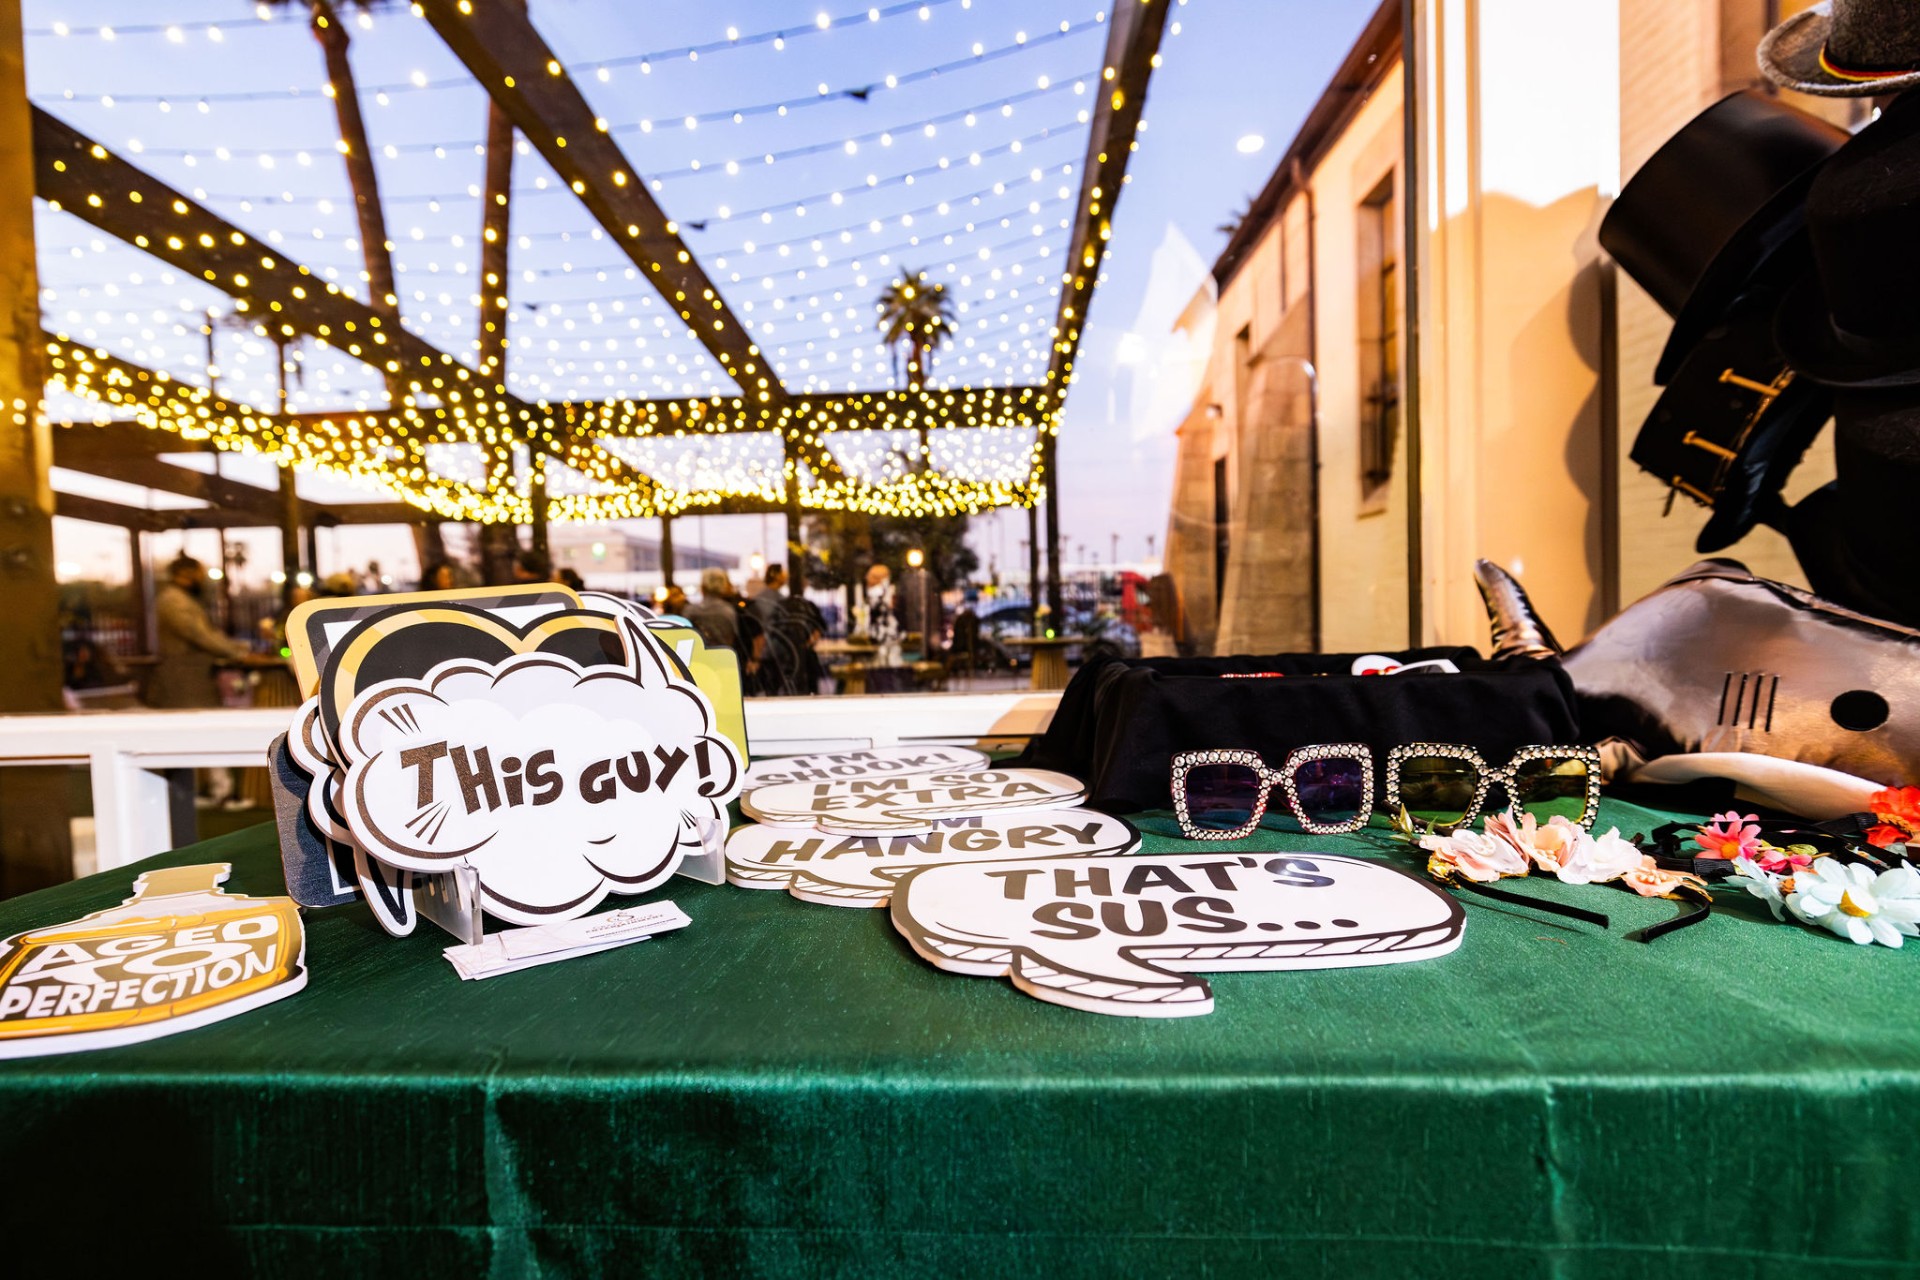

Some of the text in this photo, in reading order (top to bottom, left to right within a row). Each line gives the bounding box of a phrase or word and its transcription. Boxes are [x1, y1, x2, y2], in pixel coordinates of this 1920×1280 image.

[579, 740, 716, 804] GUY!
[755, 753, 957, 786] SHOOK!
[793, 752, 877, 768] I'M
[811, 782, 1052, 811] EXTRA
[814, 772, 1010, 796] I'M SO
[760, 822, 1103, 863] HANGRY
[984, 857, 1335, 901] THAT'S
[10, 942, 253, 985] TO
[19, 915, 279, 976] AGED
[0, 944, 277, 1020] PERFECTION
